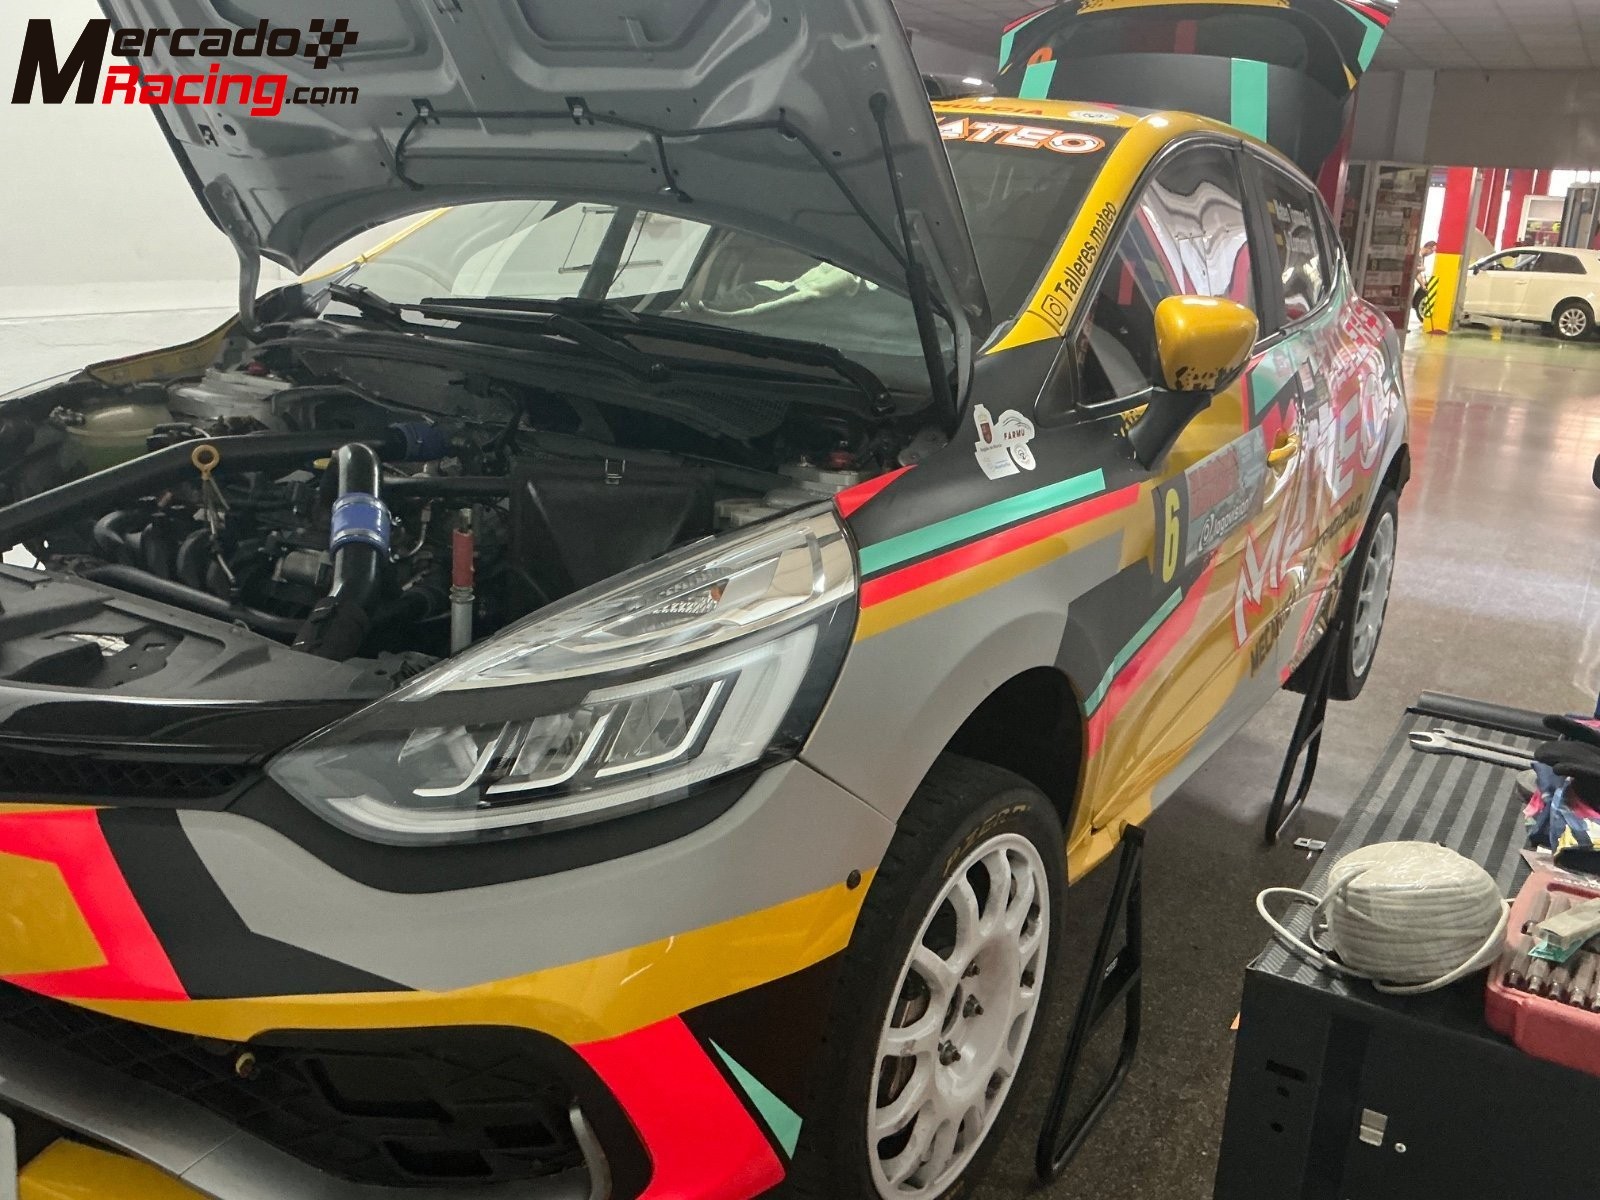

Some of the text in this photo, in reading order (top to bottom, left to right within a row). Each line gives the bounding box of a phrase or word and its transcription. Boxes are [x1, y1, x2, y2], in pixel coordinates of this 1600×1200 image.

[937, 116, 1106, 154] ATEO
[1054, 201, 1117, 302] Talleres.mateo
[1162, 488, 1180, 583] 6
